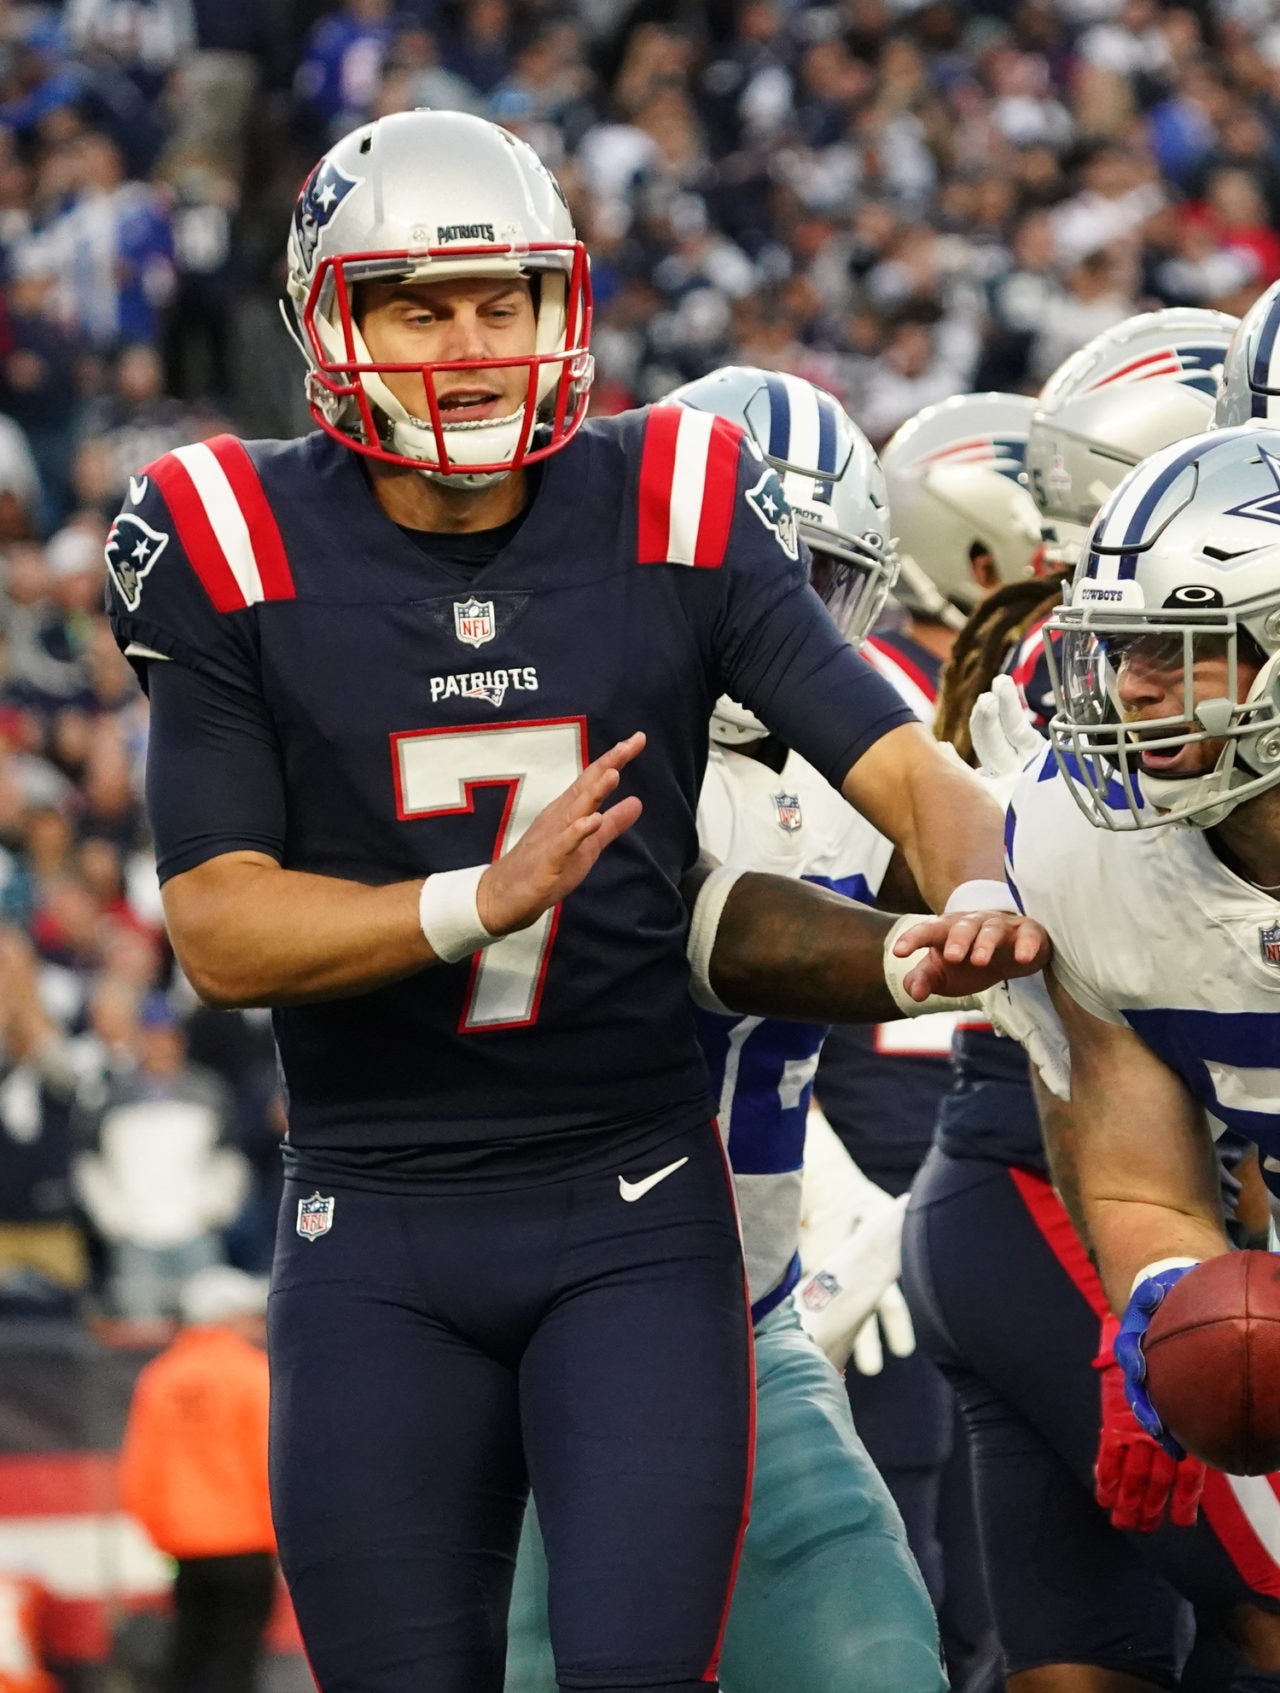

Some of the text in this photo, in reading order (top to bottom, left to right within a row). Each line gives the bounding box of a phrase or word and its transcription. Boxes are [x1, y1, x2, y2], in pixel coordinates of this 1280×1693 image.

[437, 224, 495, 245] PATRIOTS
[1082, 589, 1123, 601] COWBOYS
[463, 619, 489, 637] NFL
[430, 667, 539, 703] PATRIOTS
[389, 715, 590, 1034] 7
[303, 1214, 325, 1232] NFL
